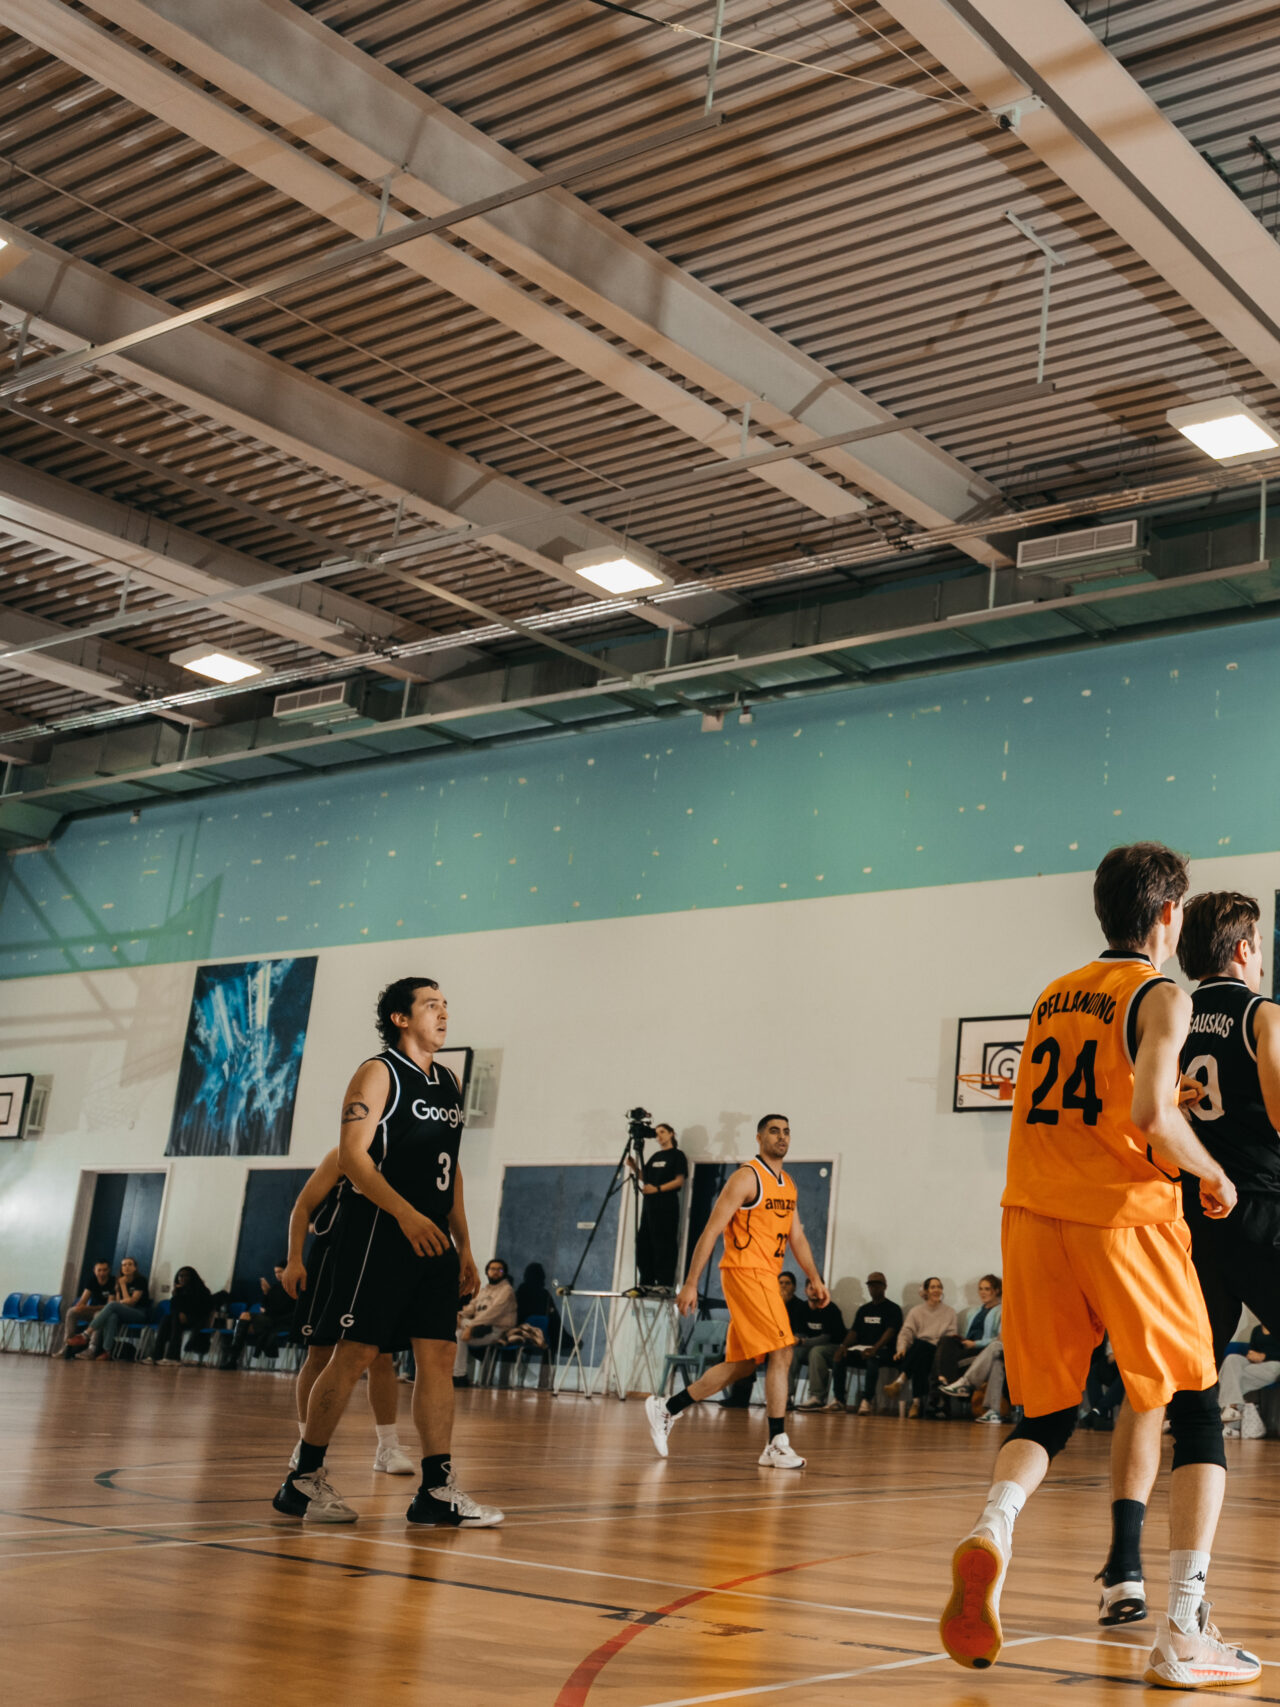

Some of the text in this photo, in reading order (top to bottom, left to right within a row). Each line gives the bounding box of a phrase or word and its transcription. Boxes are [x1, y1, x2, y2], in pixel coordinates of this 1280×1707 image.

[1037, 990, 1117, 1026] PELLANDINO
[1026, 1036, 1103, 1126] 24
[436, 1152, 452, 1191] 3
[301, 1325, 313, 1336] G
[340, 1314, 354, 1328] G
